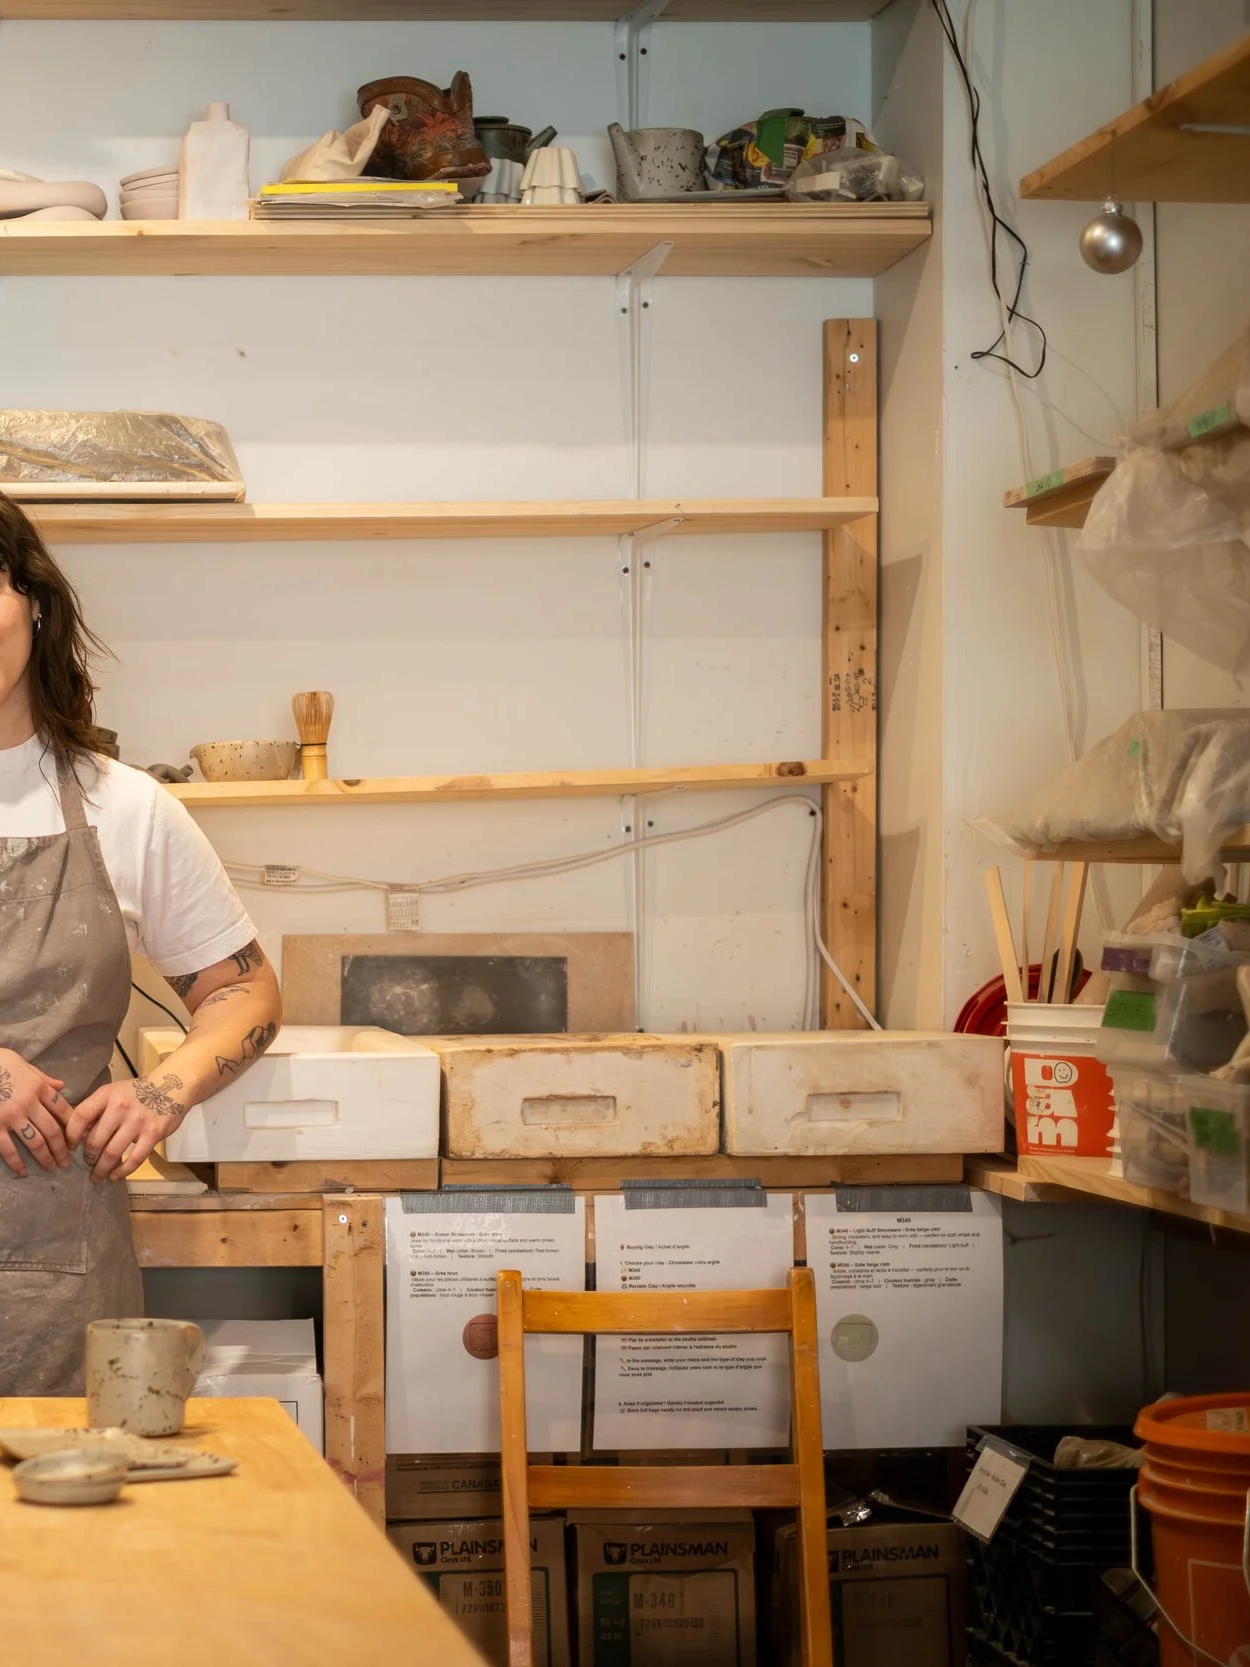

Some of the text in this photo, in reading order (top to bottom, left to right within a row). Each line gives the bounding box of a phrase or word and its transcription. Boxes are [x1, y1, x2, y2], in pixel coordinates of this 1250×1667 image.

[451, 1479, 502, 1491] CANADA
[440, 1538, 538, 1557] PLAINSN
[630, 1541, 729, 1557] PLAINSMAN
[842, 1543, 939, 1563] PLAINSMAN
[462, 1580, 503, 1598] M-350
